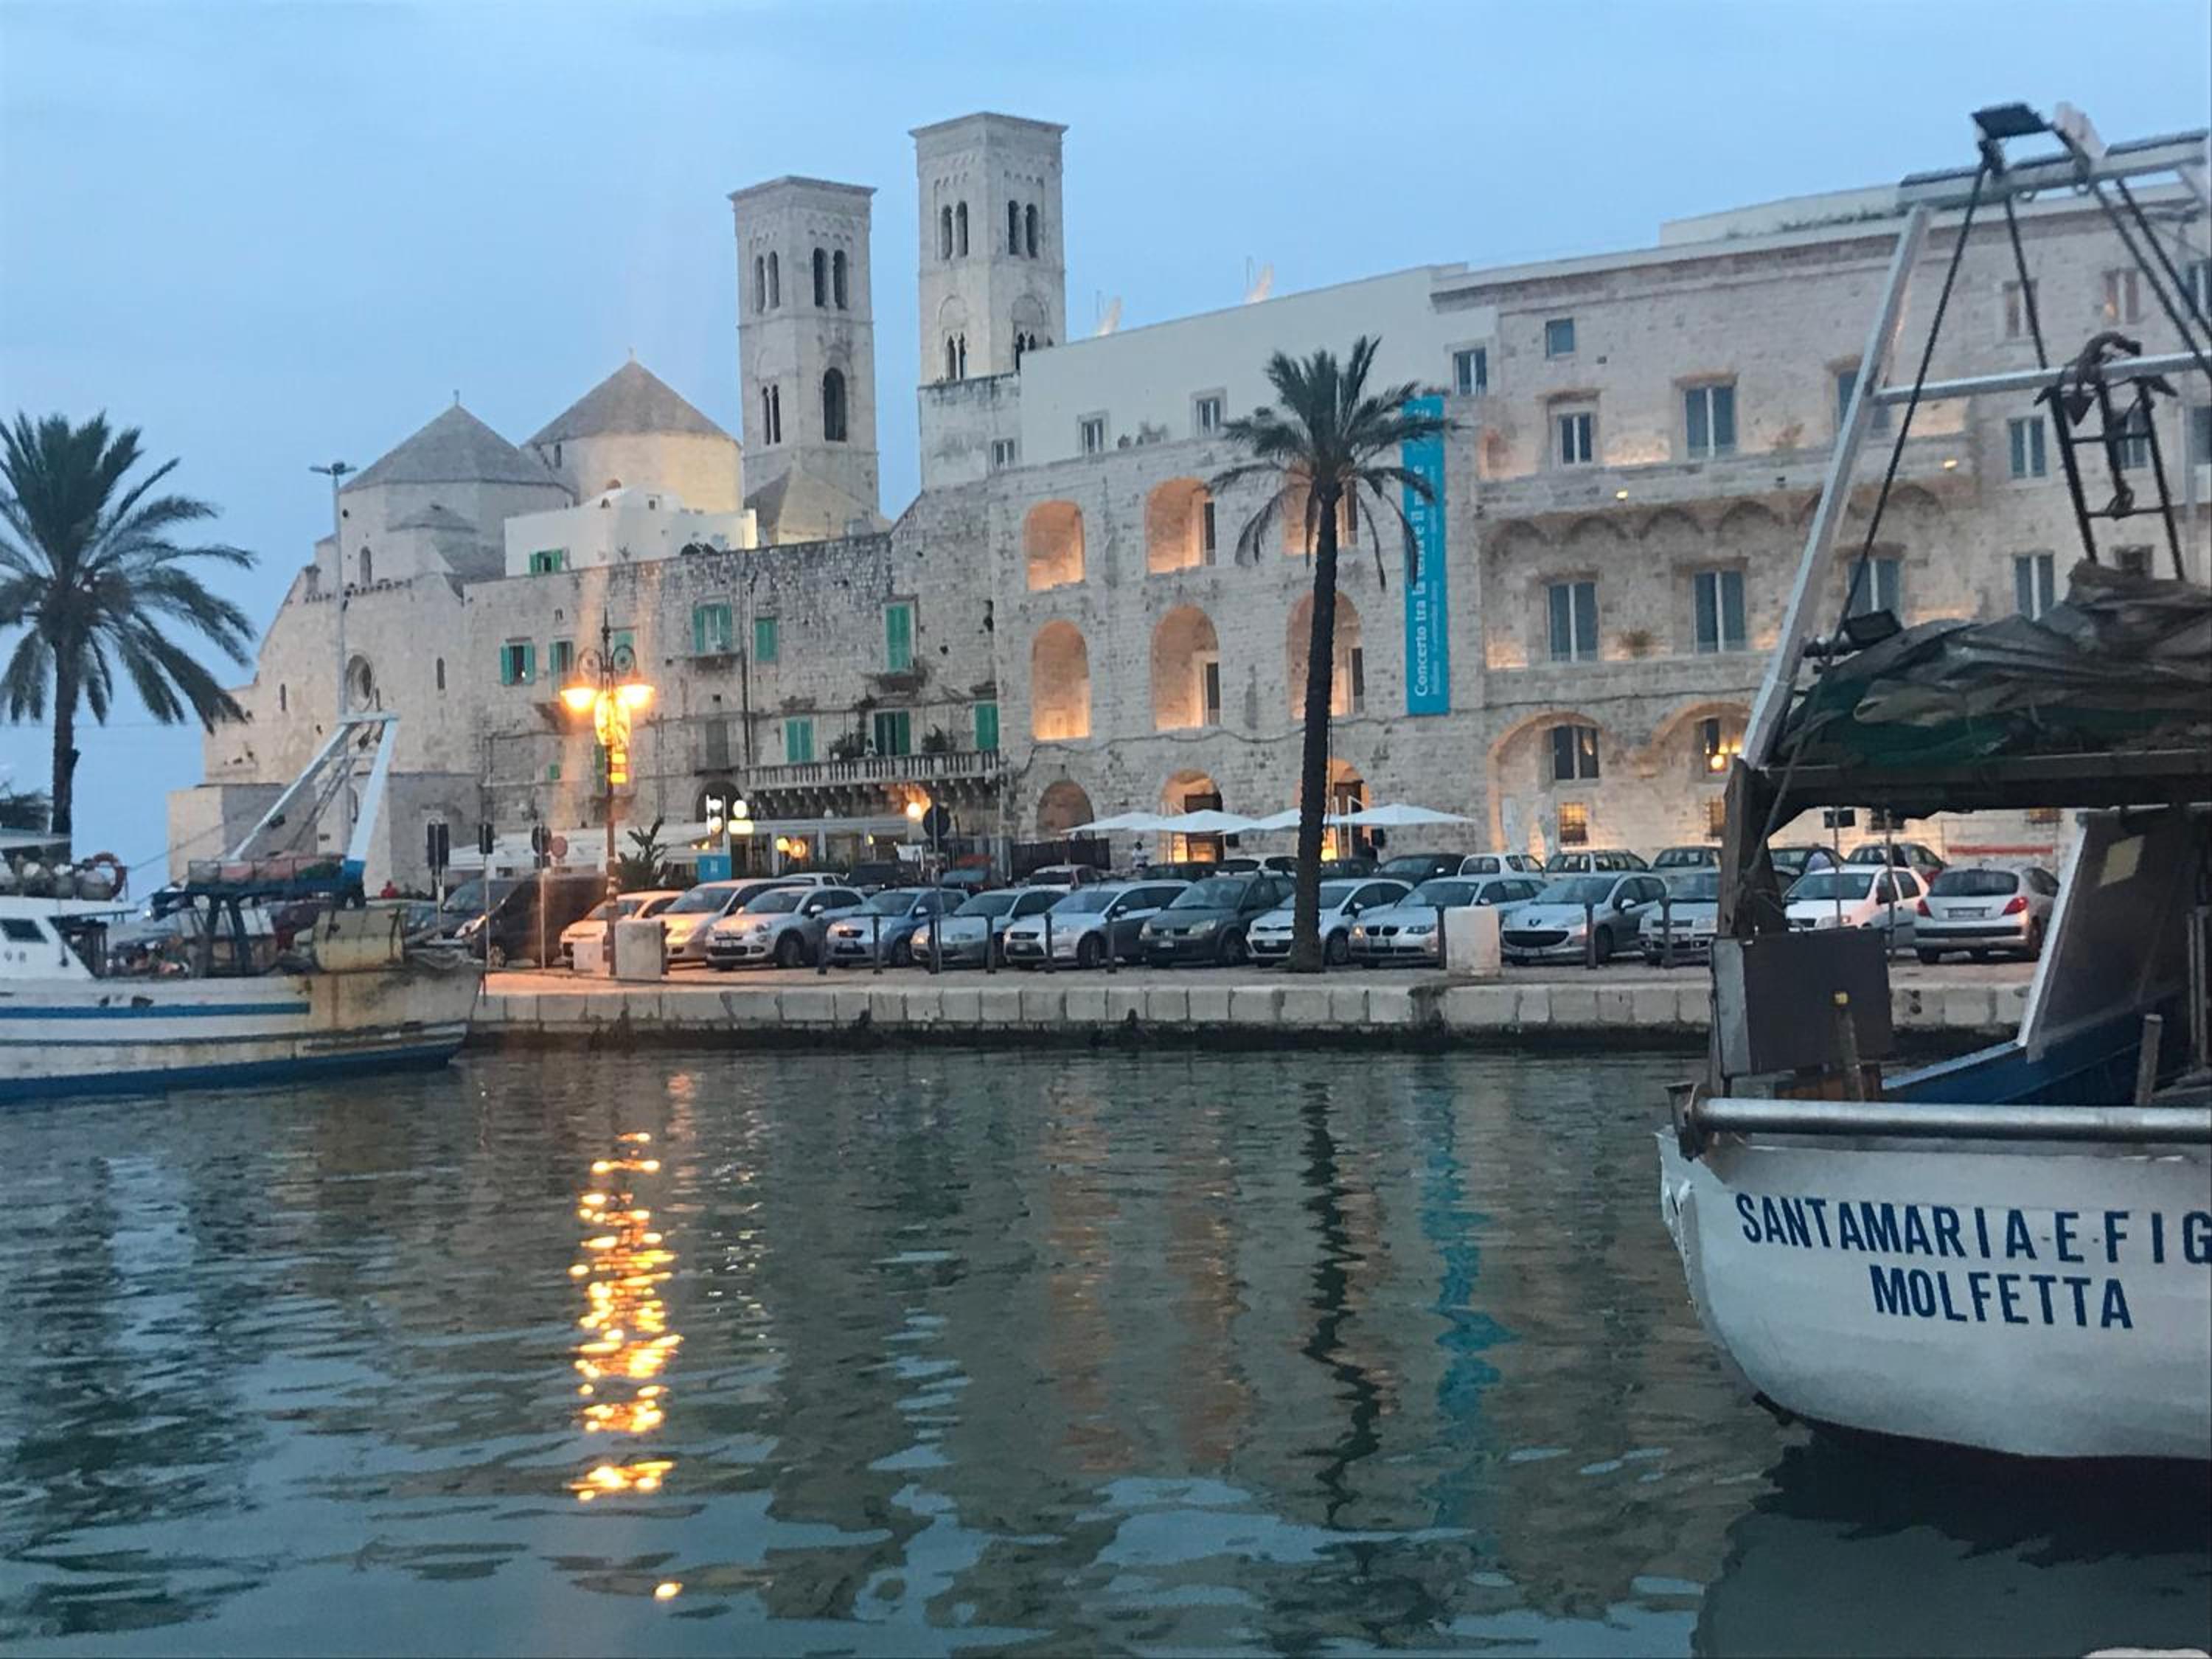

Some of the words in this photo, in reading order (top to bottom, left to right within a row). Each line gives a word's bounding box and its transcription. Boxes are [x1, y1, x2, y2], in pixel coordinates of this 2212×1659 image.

[1414, 599, 1427, 622] tra
[1413, 624, 1429, 697] Concerto
[1869, 1264, 2133, 1329] MOLFETTA
